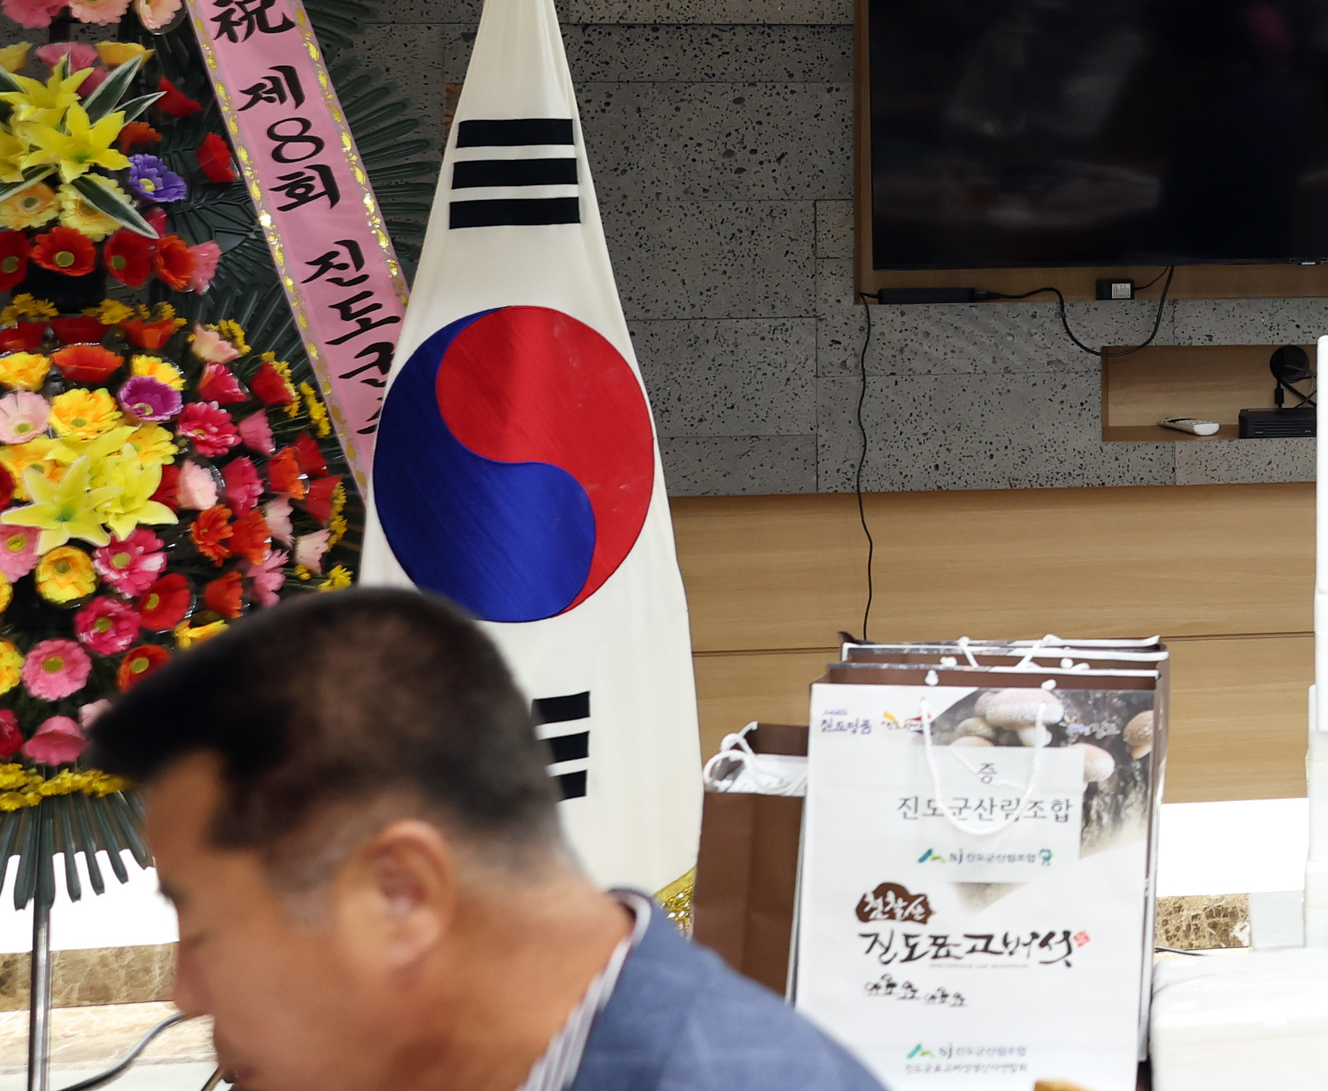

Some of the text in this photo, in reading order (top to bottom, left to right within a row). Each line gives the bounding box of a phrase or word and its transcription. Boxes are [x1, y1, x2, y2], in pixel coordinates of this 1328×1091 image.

[238, 65, 341, 213] 제8회
[301, 239, 401, 434] 진도군
[977, 762, 998, 785] 증
[858, 927, 1073, 969] 진도표고버섯
